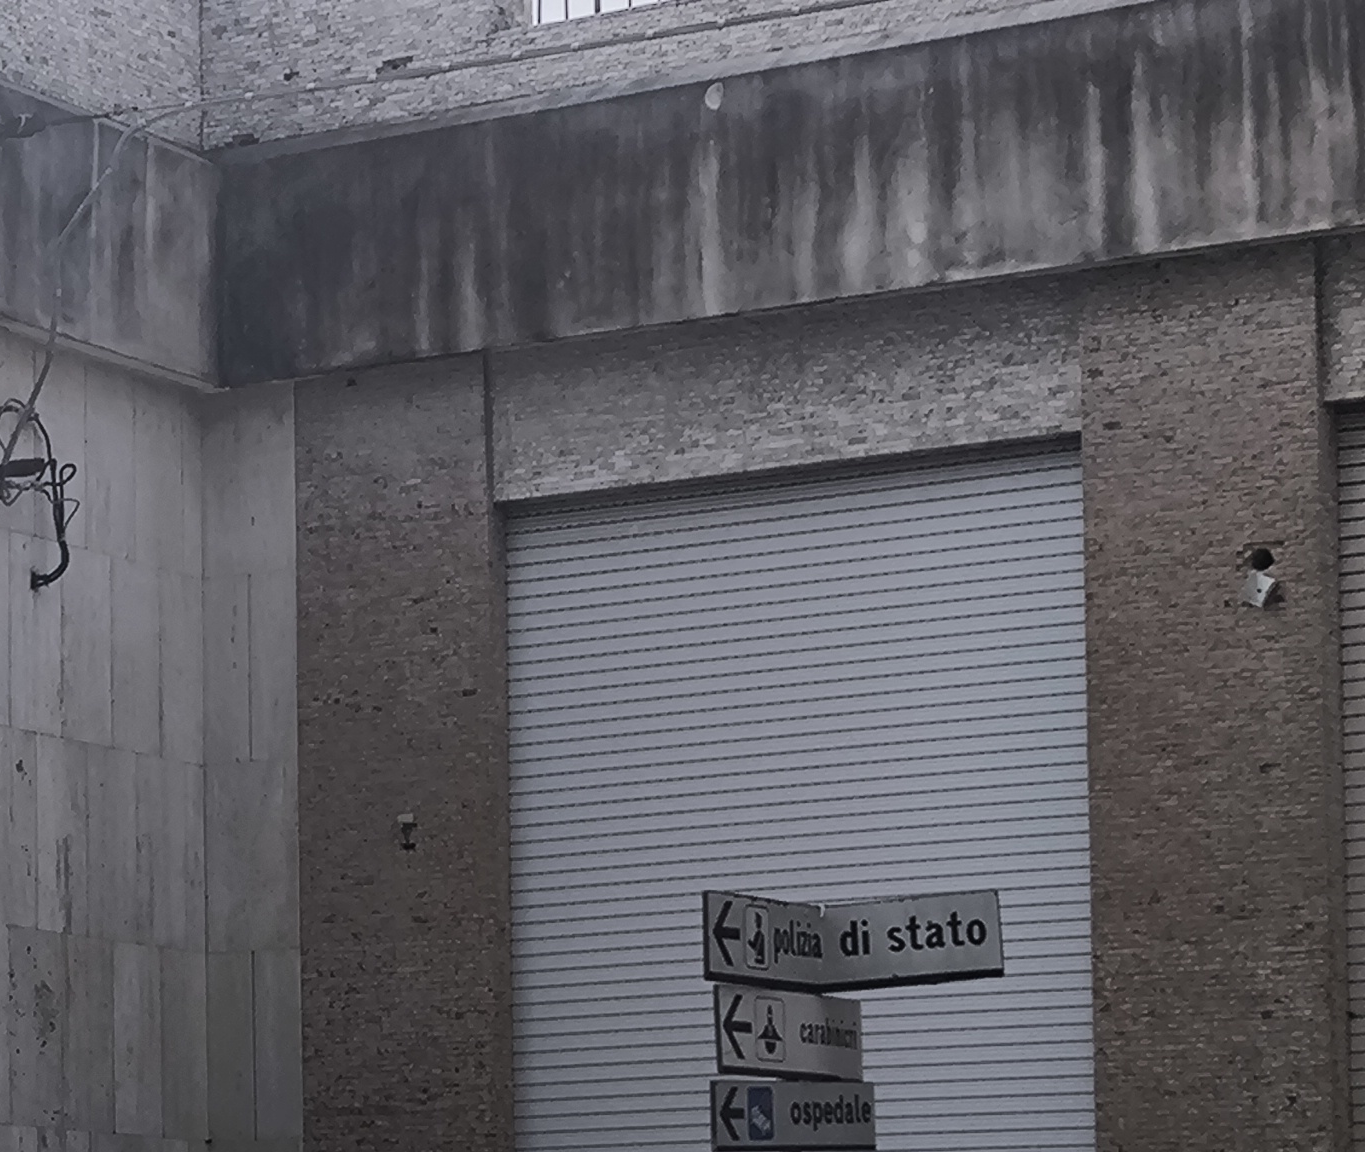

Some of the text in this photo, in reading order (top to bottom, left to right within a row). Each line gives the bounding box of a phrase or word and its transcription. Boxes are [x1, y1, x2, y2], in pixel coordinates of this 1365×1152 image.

[773, 911, 987, 964] polizia di stato
[790, 1094, 871, 1132] ospedale
